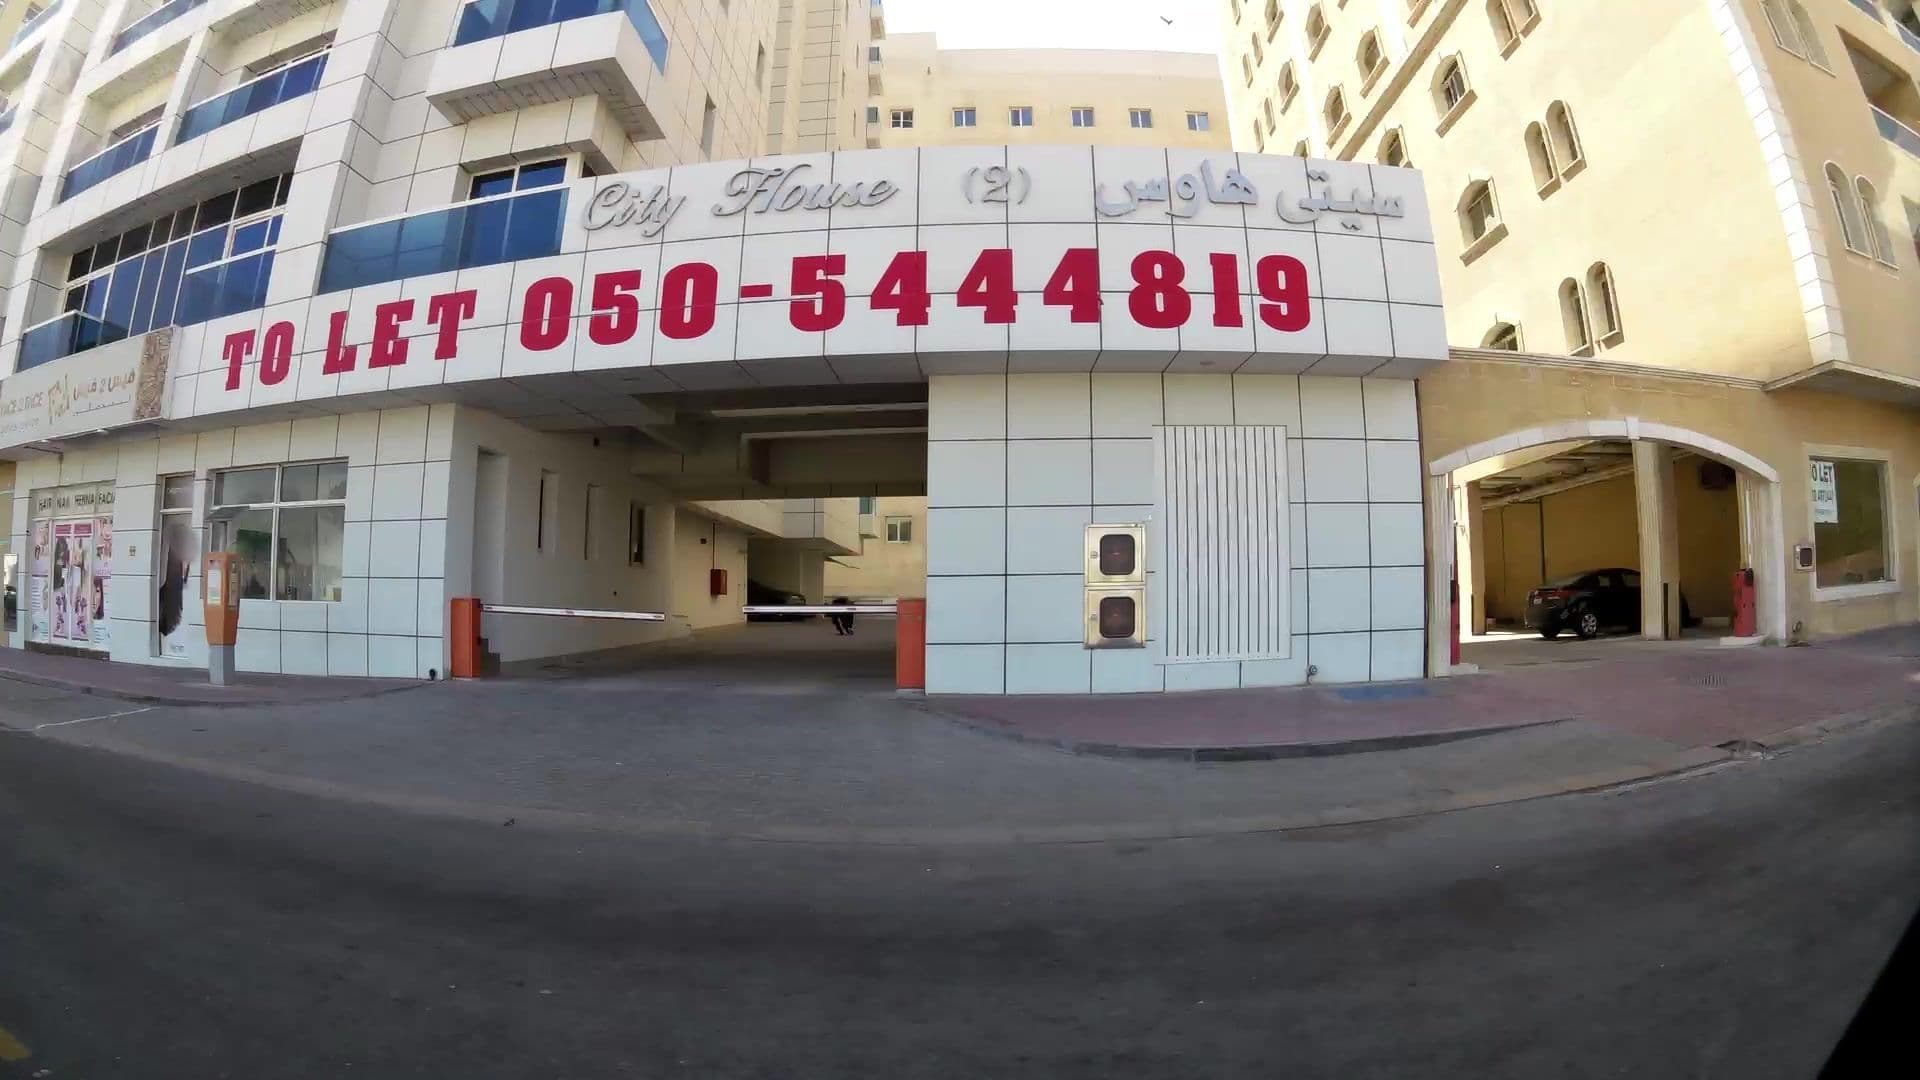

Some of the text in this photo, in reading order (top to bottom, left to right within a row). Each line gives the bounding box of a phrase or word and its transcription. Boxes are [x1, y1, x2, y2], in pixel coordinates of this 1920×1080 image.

[582, 163, 1032, 238] City House (2)
[1095, 159, 1259, 218] هاوس
[222, 248, 1312, 391] TO LET 050-5444819
[1819, 463, 1833, 483] LET
